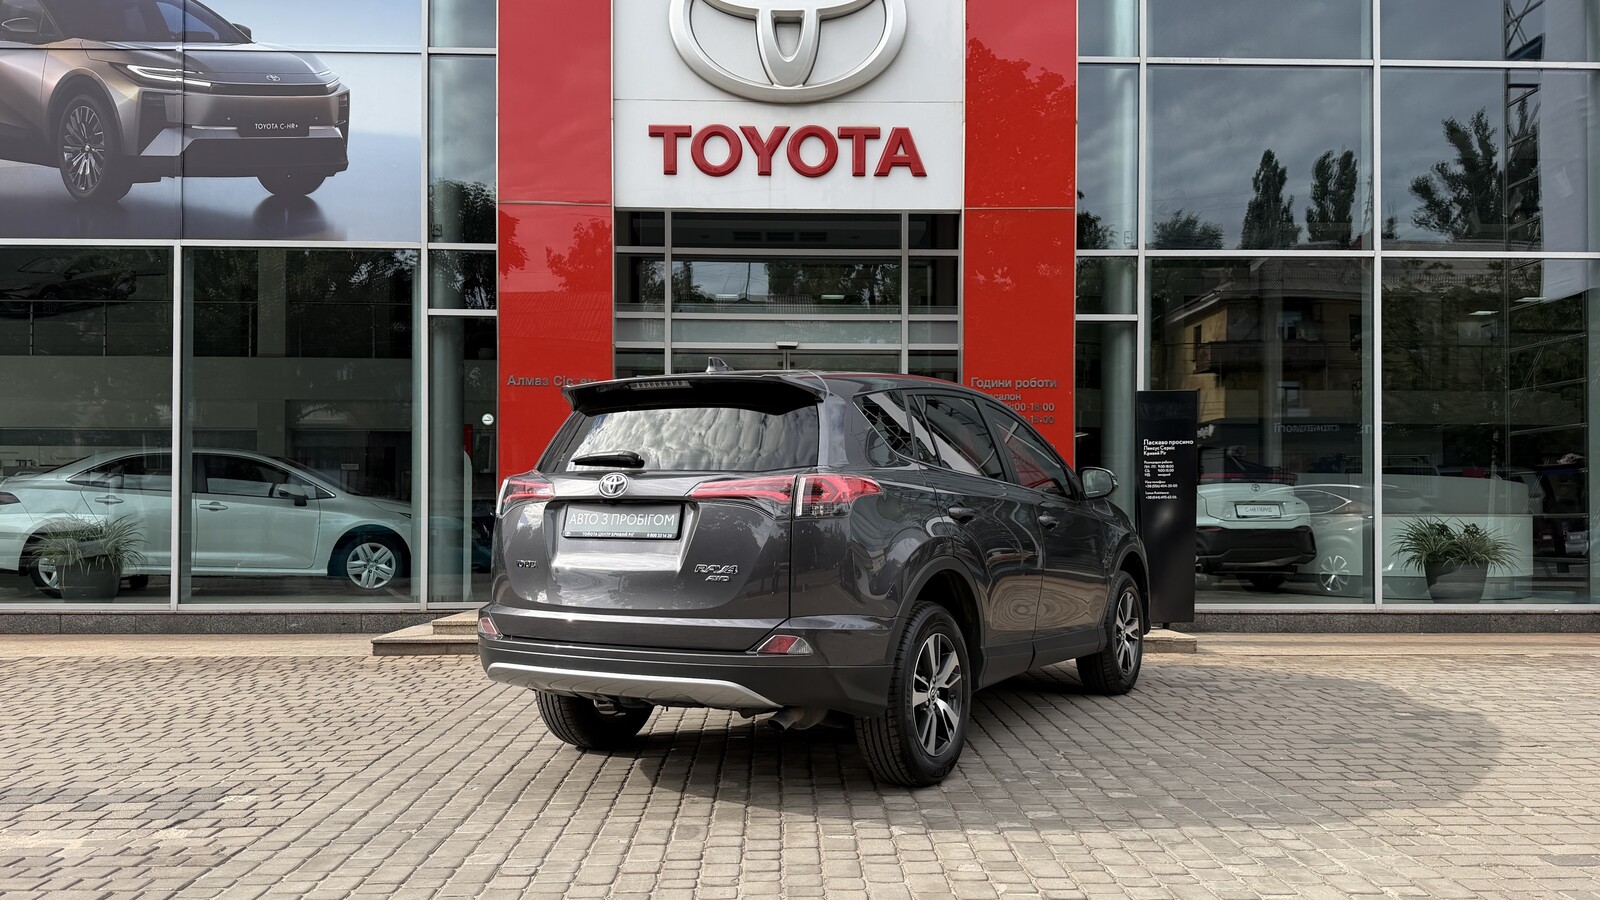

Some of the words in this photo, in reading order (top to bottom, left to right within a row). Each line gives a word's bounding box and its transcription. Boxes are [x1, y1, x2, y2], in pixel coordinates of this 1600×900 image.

[649, 124, 928, 177] TOYOTA
[507, 375, 549, 386] Алмаз
[970, 377, 1012, 389] Години
[1015, 377, 1057, 389] роботи
[569, 513, 599, 525] АВТО
[601, 513, 609, 525] З
[610, 513, 675, 526] ПРОБІГОМ
[694, 563, 738, 574] RAV4
